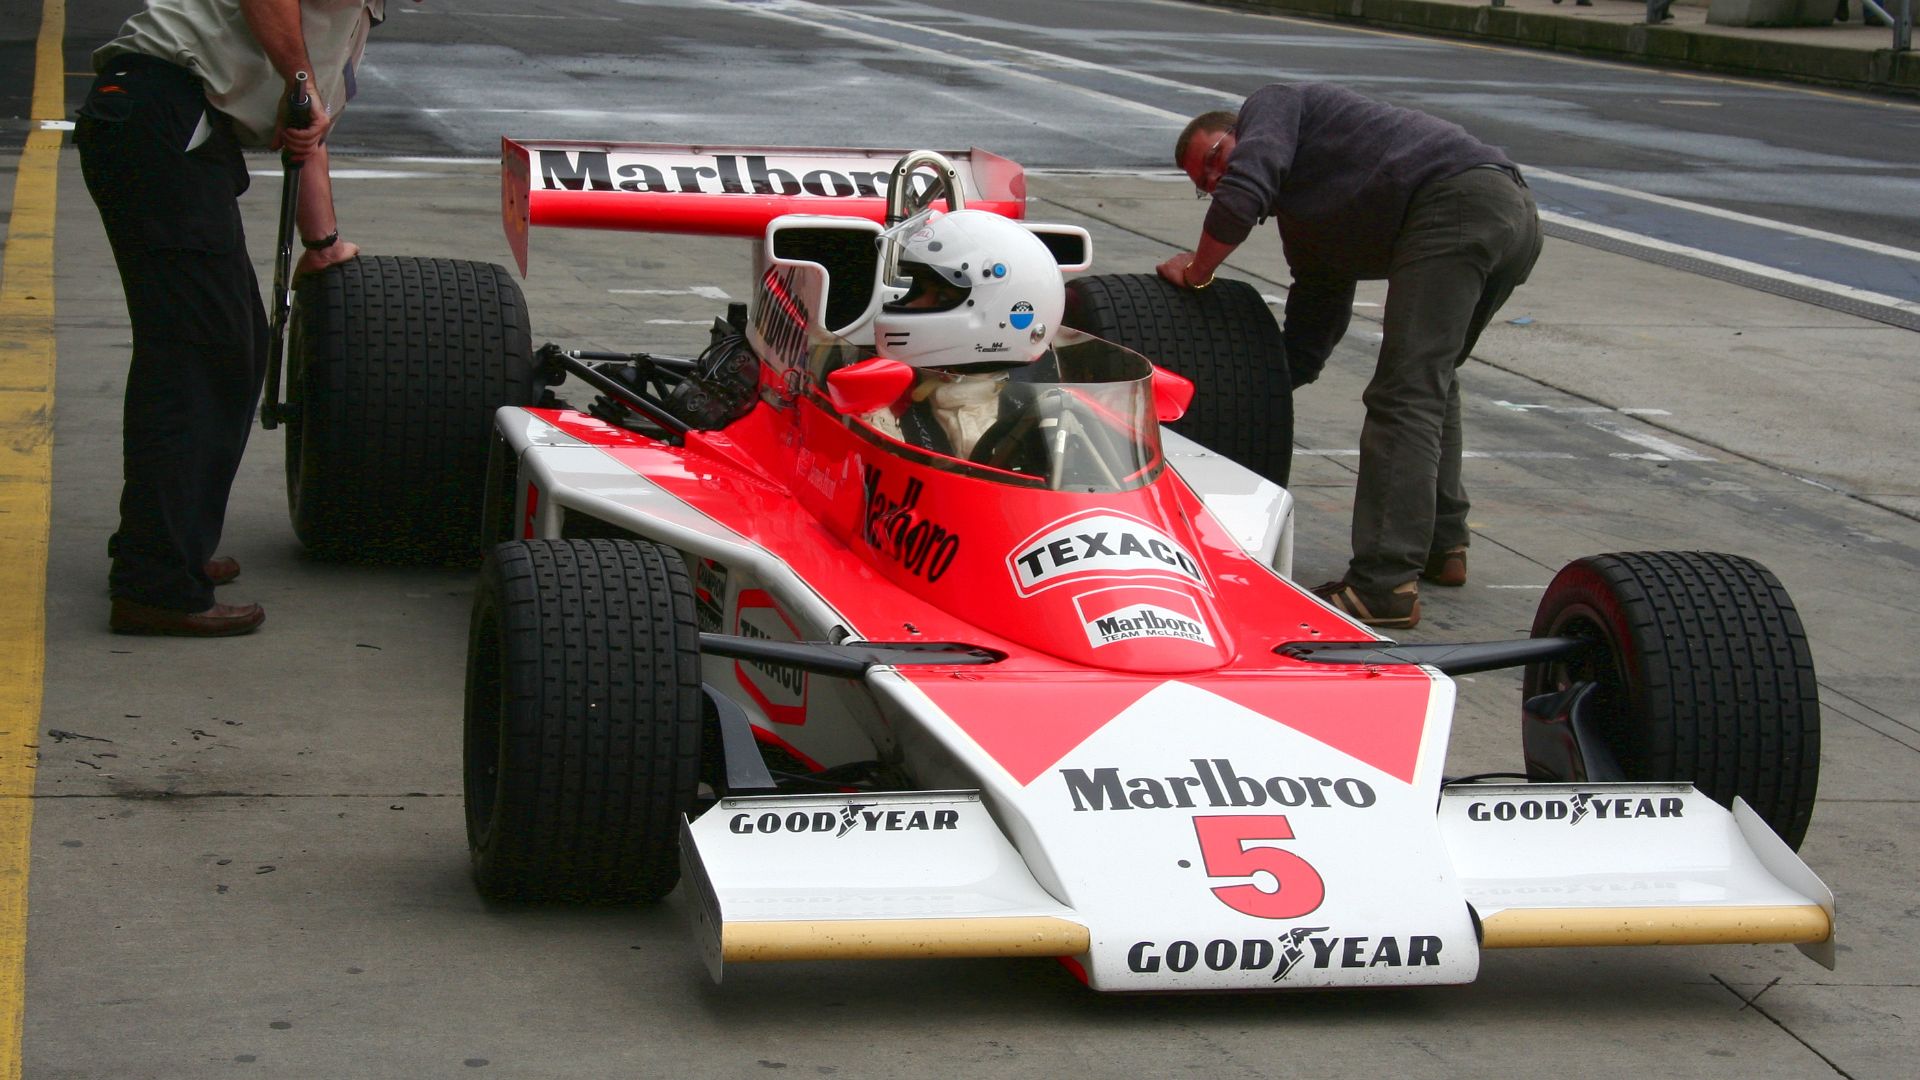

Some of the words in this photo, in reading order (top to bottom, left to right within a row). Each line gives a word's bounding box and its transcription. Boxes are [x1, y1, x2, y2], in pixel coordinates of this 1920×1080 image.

[1017, 532, 1203, 580] TEXACO
[1095, 610, 1202, 636] Marlboro
[1103, 630, 1140, 643] TEAM
[1059, 759, 1377, 812] Marlboro
[1192, 814, 1326, 920] 5
